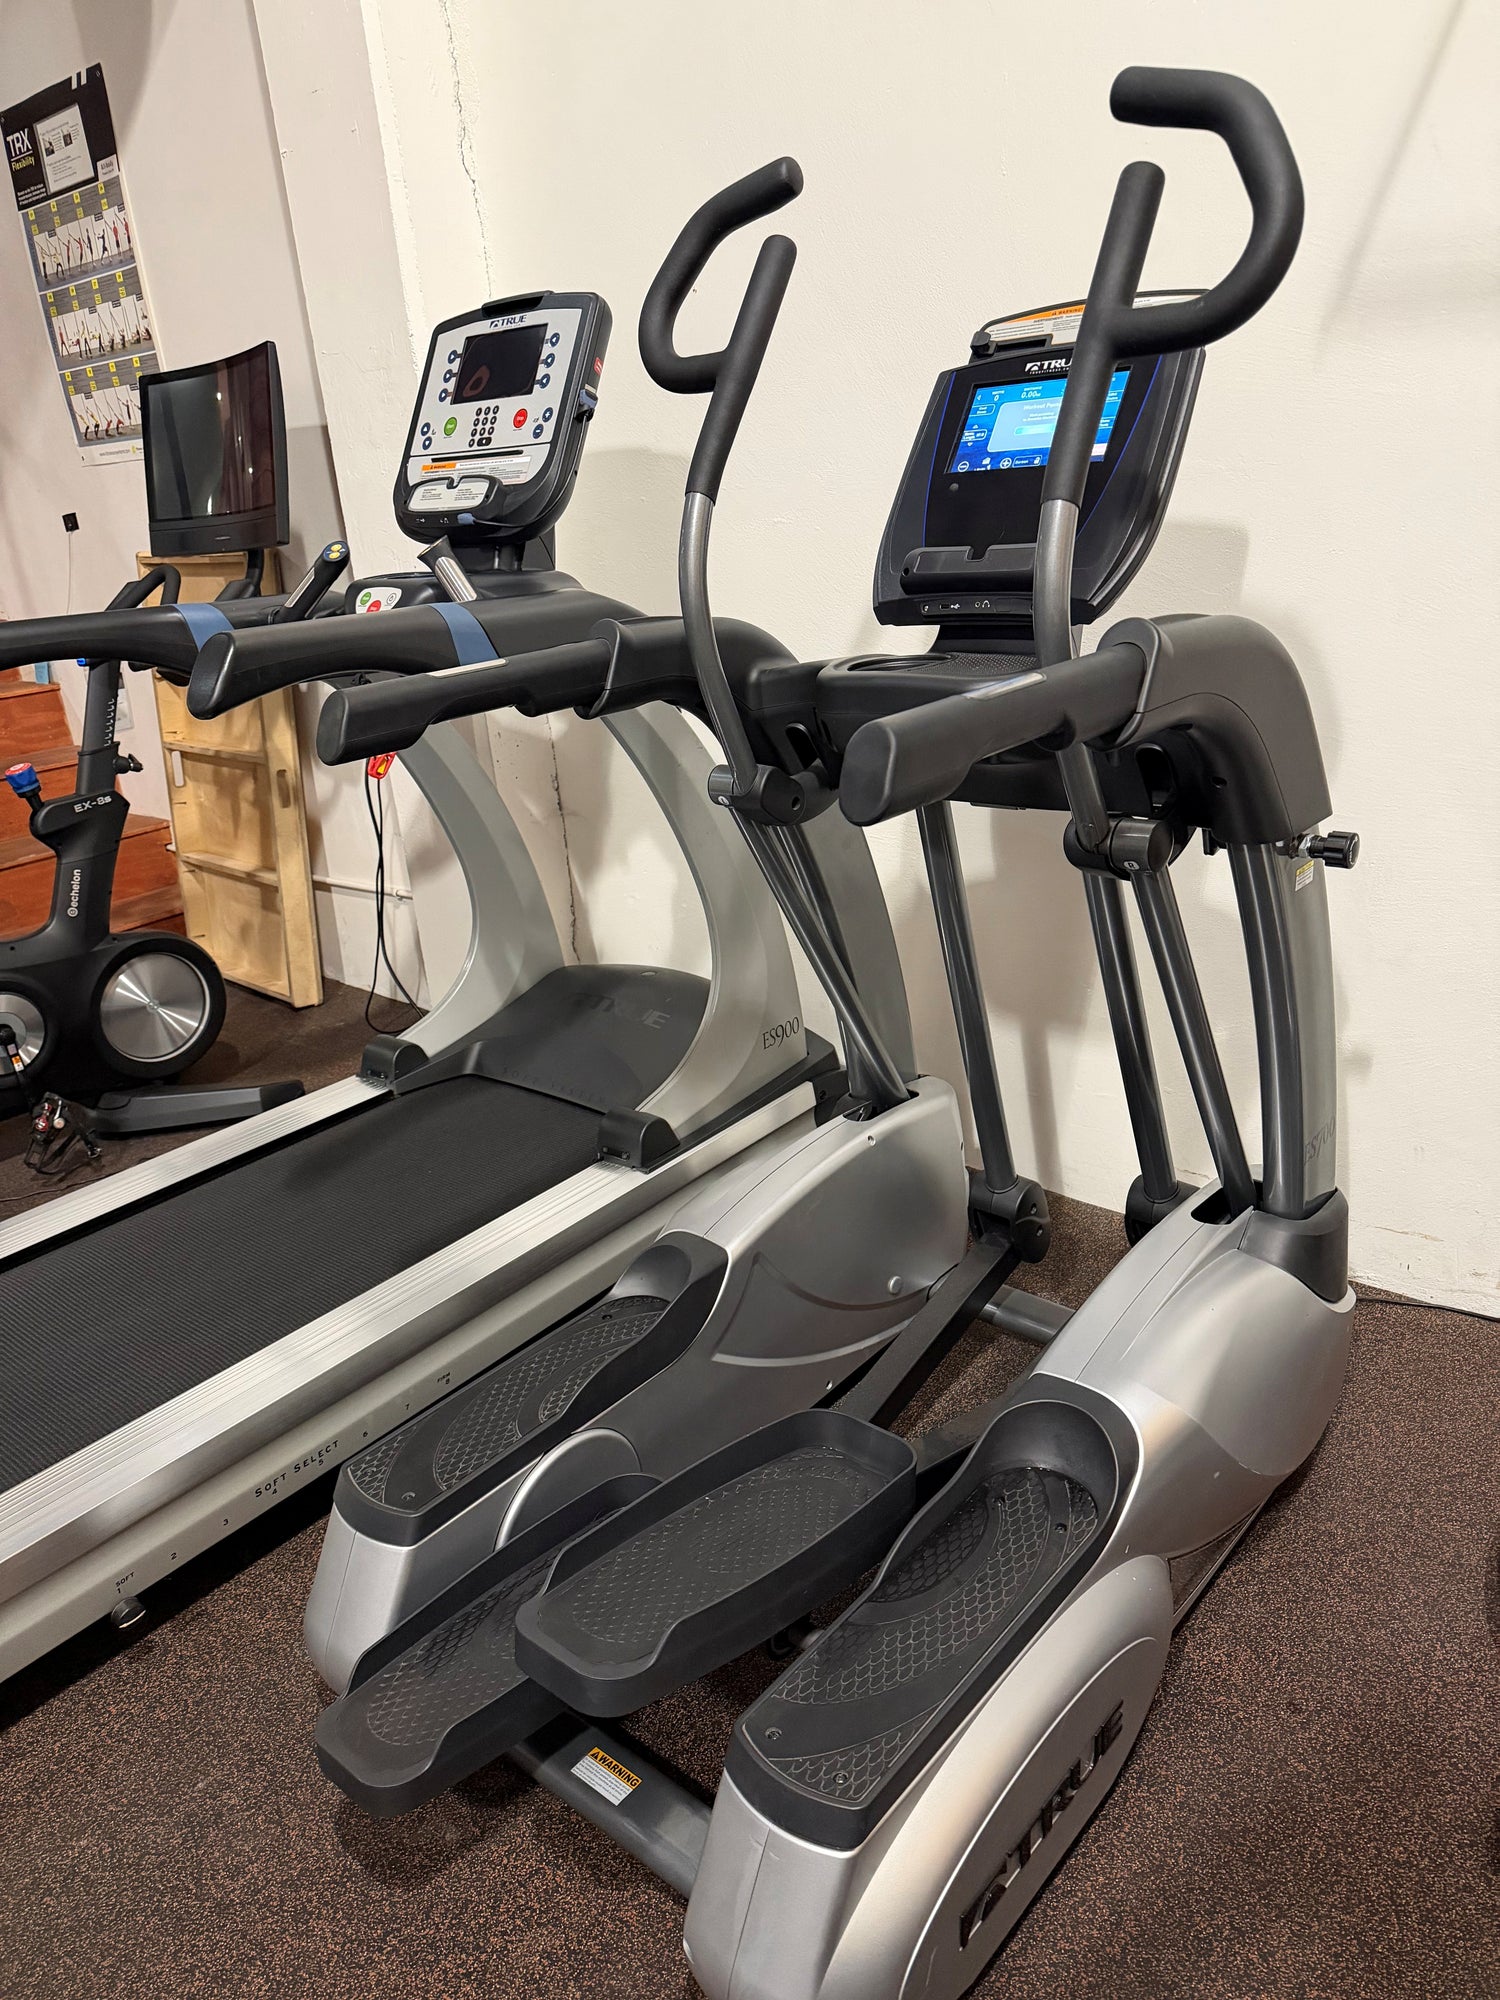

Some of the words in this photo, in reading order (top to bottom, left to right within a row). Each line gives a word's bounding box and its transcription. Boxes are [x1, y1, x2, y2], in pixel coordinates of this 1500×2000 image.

[6, 127, 32, 157] TRX
[11, 156, 35, 172] Flexibility
[500, 314, 527, 326] TRUE
[1041, 357, 1073, 370] TRU
[73, 795, 113, 813] EX-8s
[69, 868, 82, 908] echelon
[762, 1016, 801, 1050] ES900
[1303, 1115, 1337, 1167] ES700
[254, 1472, 287, 1498] SOFT
[293, 1440, 339, 1474] SELECT
[318, 1458, 324, 1466] 5
[271, 1487, 278, 1495] 4
[222, 1518, 229, 1526] 3
[170, 1552, 178, 1560] 2
[115, 1571, 135, 1588] SOFT
[598, 1753, 640, 1788] WARNING
